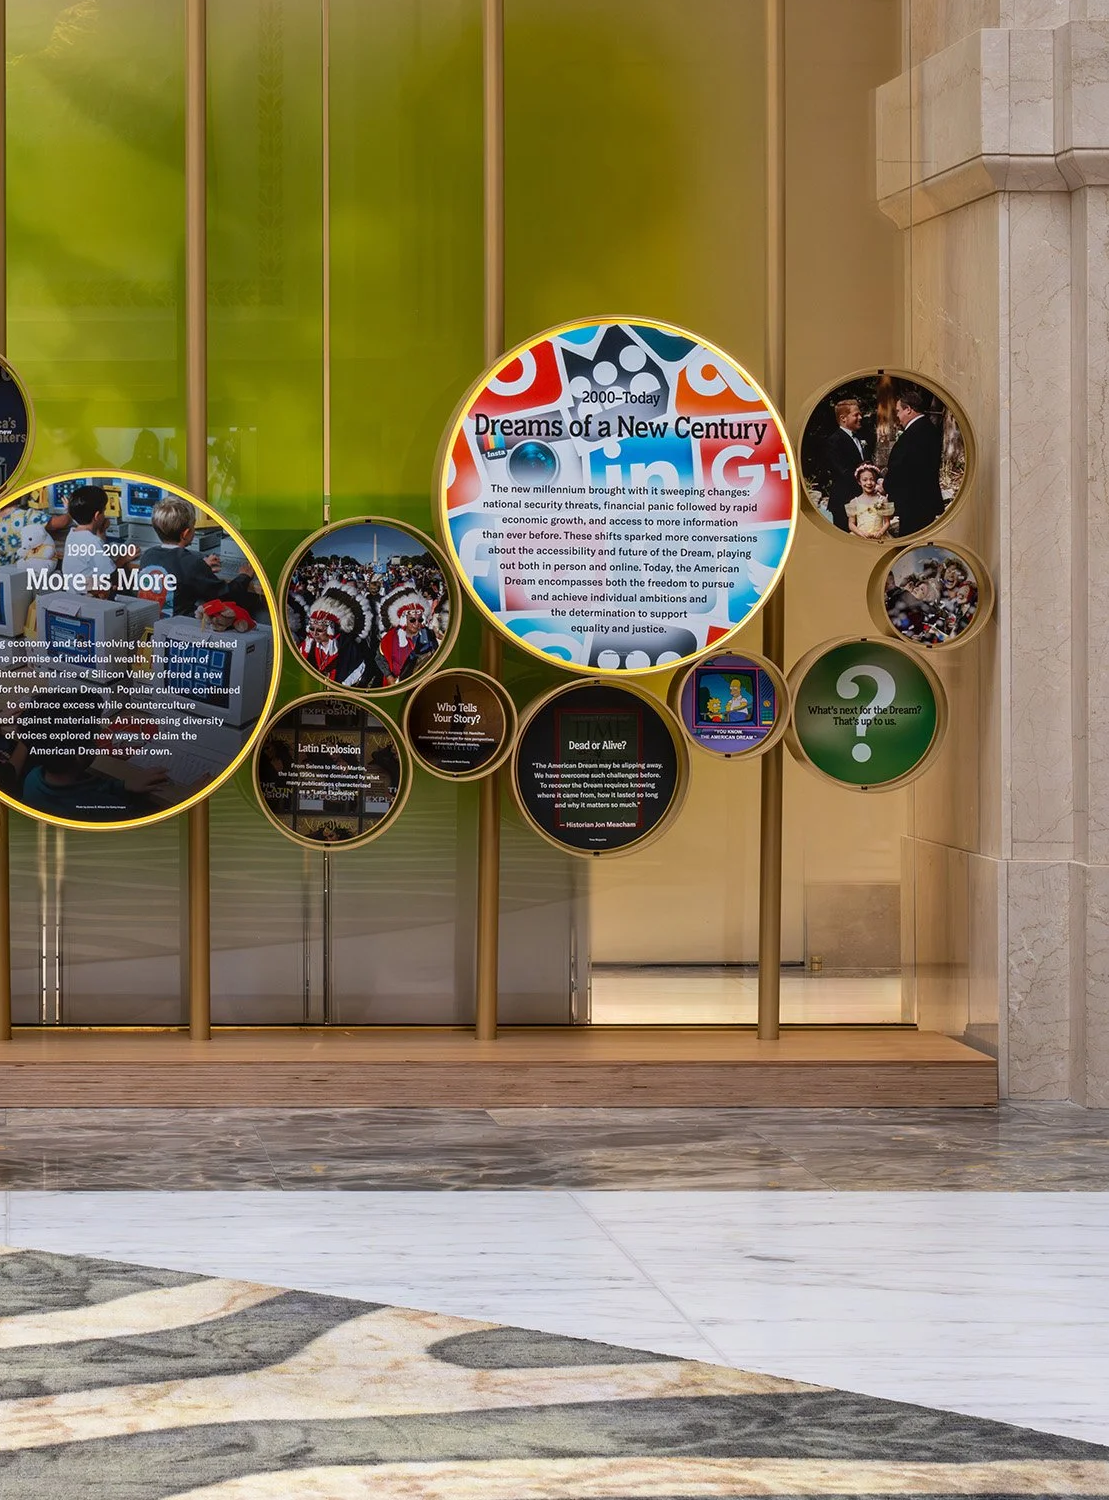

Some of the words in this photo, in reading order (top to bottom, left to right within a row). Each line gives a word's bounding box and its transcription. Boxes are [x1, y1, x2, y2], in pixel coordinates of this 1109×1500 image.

[582, 390, 661, 407] 2000–Today
[475, 413, 563, 437] Dreams
[569, 413, 593, 437] of
[598, 421, 611, 438] a
[617, 414, 669, 438] New
[675, 416, 768, 445] Century
[491, 484, 508, 493] The
[533, 485, 586, 494] millennium
[589, 486, 626, 496] brought
[628, 487, 648, 495] with
[651, 487, 658, 495] it
[660, 487, 705, 498] sweeping
[707, 487, 750, 498] changes:
[67, 544, 136, 556] 1990–2000
[26, 567, 87, 591] More
[91, 567, 111, 591] is
[117, 568, 177, 591] More
[571, 624, 610, 634] equality
[612, 624, 629, 633] and
[632, 625, 667, 635] justice.
[7, 640, 50, 649] economy
[53, 639, 70, 647] and
[73, 639, 134, 649] fast-evolving
[137, 639, 190, 650] technology
[192, 639, 237, 648] refreshed
[0, 670, 36, 678] internet
[39, 670, 57, 678] and
[59, 670, 77, 678] rise
[79, 669, 89, 678] of
[91, 669, 124, 678] Silicon
[126, 670, 155, 680] Valley
[157, 670, 192, 679] offered
[437, 703, 457, 712] Who
[458, 703, 477, 712] Tells
[839, 706, 858, 714] next
[860, 705, 871, 714] for
[874, 706, 888, 714] the
[889, 705, 922, 715] Dream?
[433, 713, 452, 722] Your
[454, 714, 481, 725] Story?
[860, 719, 872, 728] up
[874, 717, 883, 726] to
[884, 718, 897, 726] us.
[298, 743, 319, 753] Latin
[321, 744, 361, 755] Explosion
[569, 741, 590, 750] Dead
[602, 741, 627, 750] Alive?
